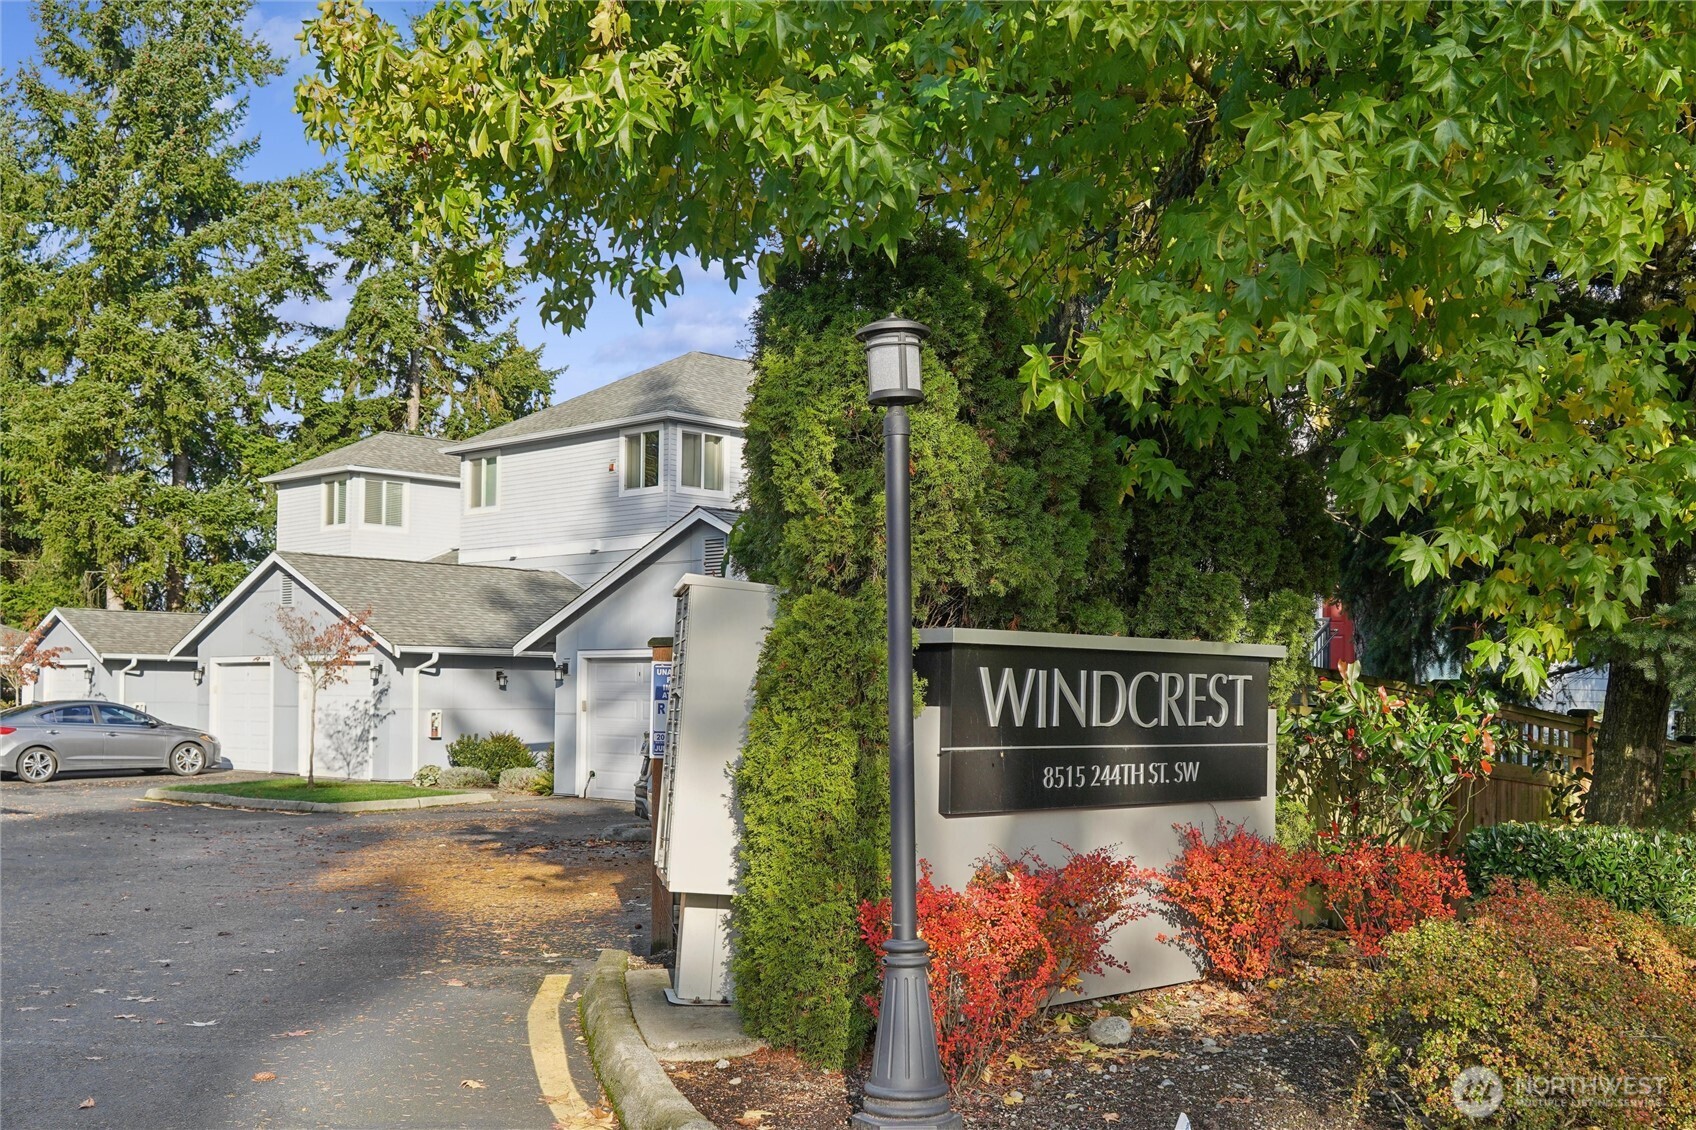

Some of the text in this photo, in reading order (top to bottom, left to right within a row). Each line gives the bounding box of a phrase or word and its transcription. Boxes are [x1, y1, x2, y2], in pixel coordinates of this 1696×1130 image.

[979, 666, 1252, 728] WINDCREST
[1043, 761, 1200, 788] 8515 244TH ST. SW
